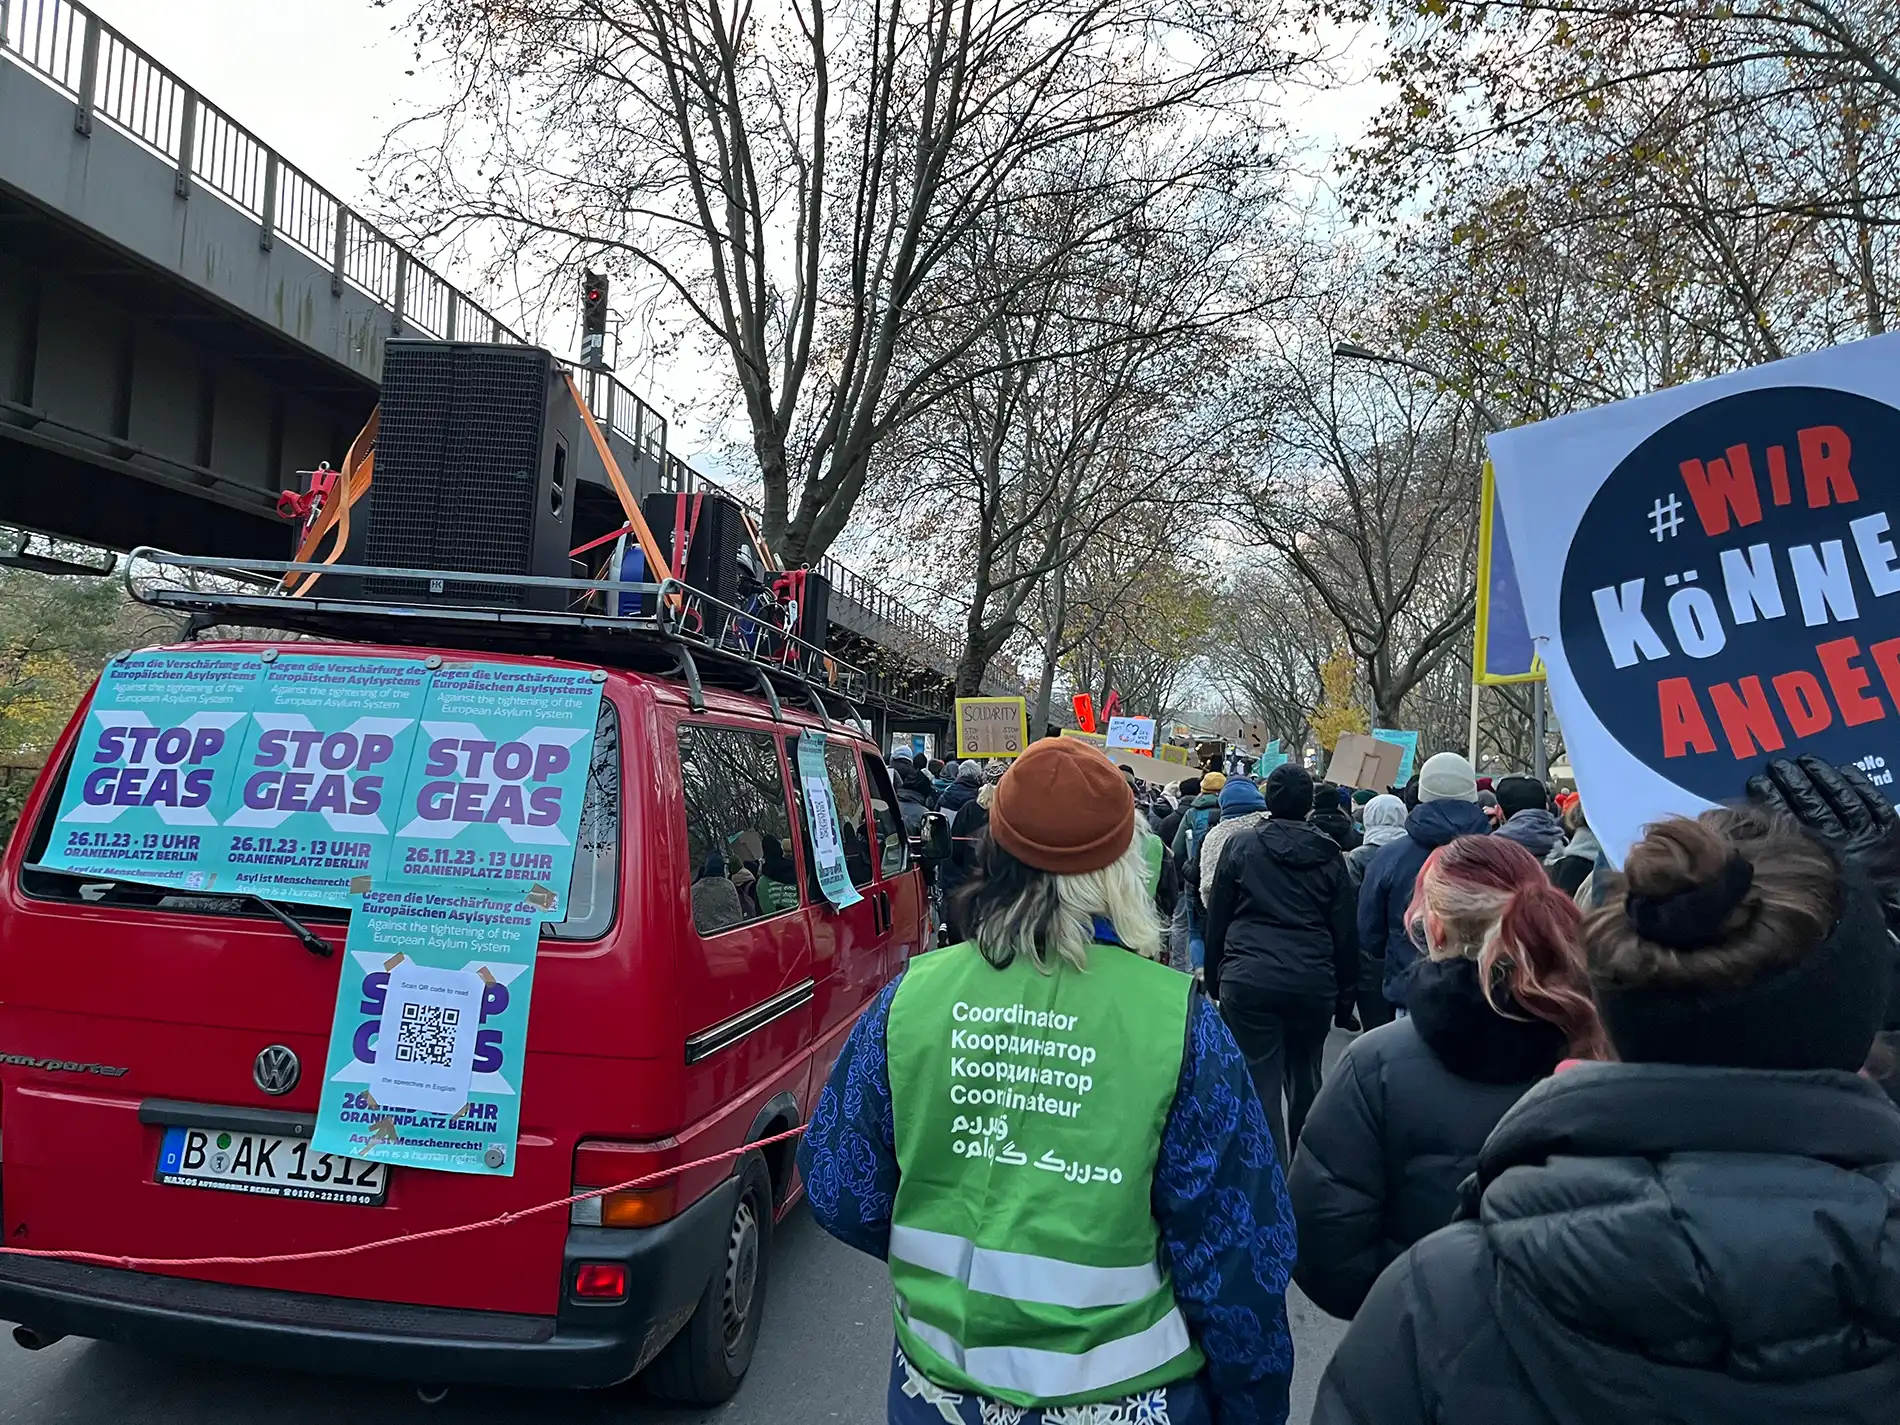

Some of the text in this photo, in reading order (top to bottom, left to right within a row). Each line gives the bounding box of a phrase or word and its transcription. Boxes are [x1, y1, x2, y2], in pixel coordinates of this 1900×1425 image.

[147, 659, 164, 669] die
[166, 659, 240, 671] Verschärfung
[242, 660, 262, 670] des
[269, 662, 427, 677] Gegen die Verschärfung des
[110, 670, 257, 682] Europäischen Asylsystems
[268, 672, 421, 687] Europäischen Asylsystems
[432, 669, 593, 686] Gegen die Verschärfung de
[271, 684, 410, 699] Against the tightening of the
[432, 679, 593, 697] Europäischen Asylsystems
[274, 696, 400, 710] European Asylum System
[437, 692, 583, 708] Against the tightening of the
[441, 704, 573, 720] European Asylum System
[93, 726, 225, 765] STOP
[253, 729, 394, 771] STOP
[425, 738, 571, 782] STOP
[83, 767, 215, 808] GEAS
[243, 771, 384, 815] GEAS
[416, 781, 563, 827] GEAS
[68, 831, 131, 847] 26.11.23
[143, 834, 158, 848] 13
[162, 834, 200, 849] UHR
[230, 836, 298, 853] 26.11.23
[310, 840, 327, 856] 13
[330, 841, 372, 858] UHR
[63, 847, 198, 862] ORANIENPLATZ BERLIN
[228, 852, 370, 869] ORANIENPLATZ BERLIN
[405, 847, 476, 865] 26.11.23
[489, 851, 506, 867] 13
[510, 853, 553, 869] UHR
[236, 873, 350, 887] Asyl ist Menschenrecht
[403, 864, 552, 881] ORANIENPLATZ BERLIN
[362, 891, 537, 913] Gegen die Verschärfung des
[362, 903, 532, 927] Europäischen Asylsystems
[368, 918, 521, 941] Against the tightening of the
[373, 932, 511, 953] European Asylum System
[401, 981, 418, 989] Scan
[360, 971, 510, 1024] SP
[952, 1002, 1078, 1031] Coordinator
[951, 1029, 1096, 1067] Координатор
[0, 1051, 129, 1077] ransporter
[950, 1085, 1081, 1118] Coorinateur
[467, 1102, 498, 1120] HR
[449, 1119, 497, 1133] BERLIN
[349, 1133, 372, 1146] Asy
[397, 1136, 483, 1150] Menschenrecht!
[167, 1153, 176, 1165] D
[183, 1129, 378, 1188] B AK 1312
[411, 1149, 448, 1162] human
